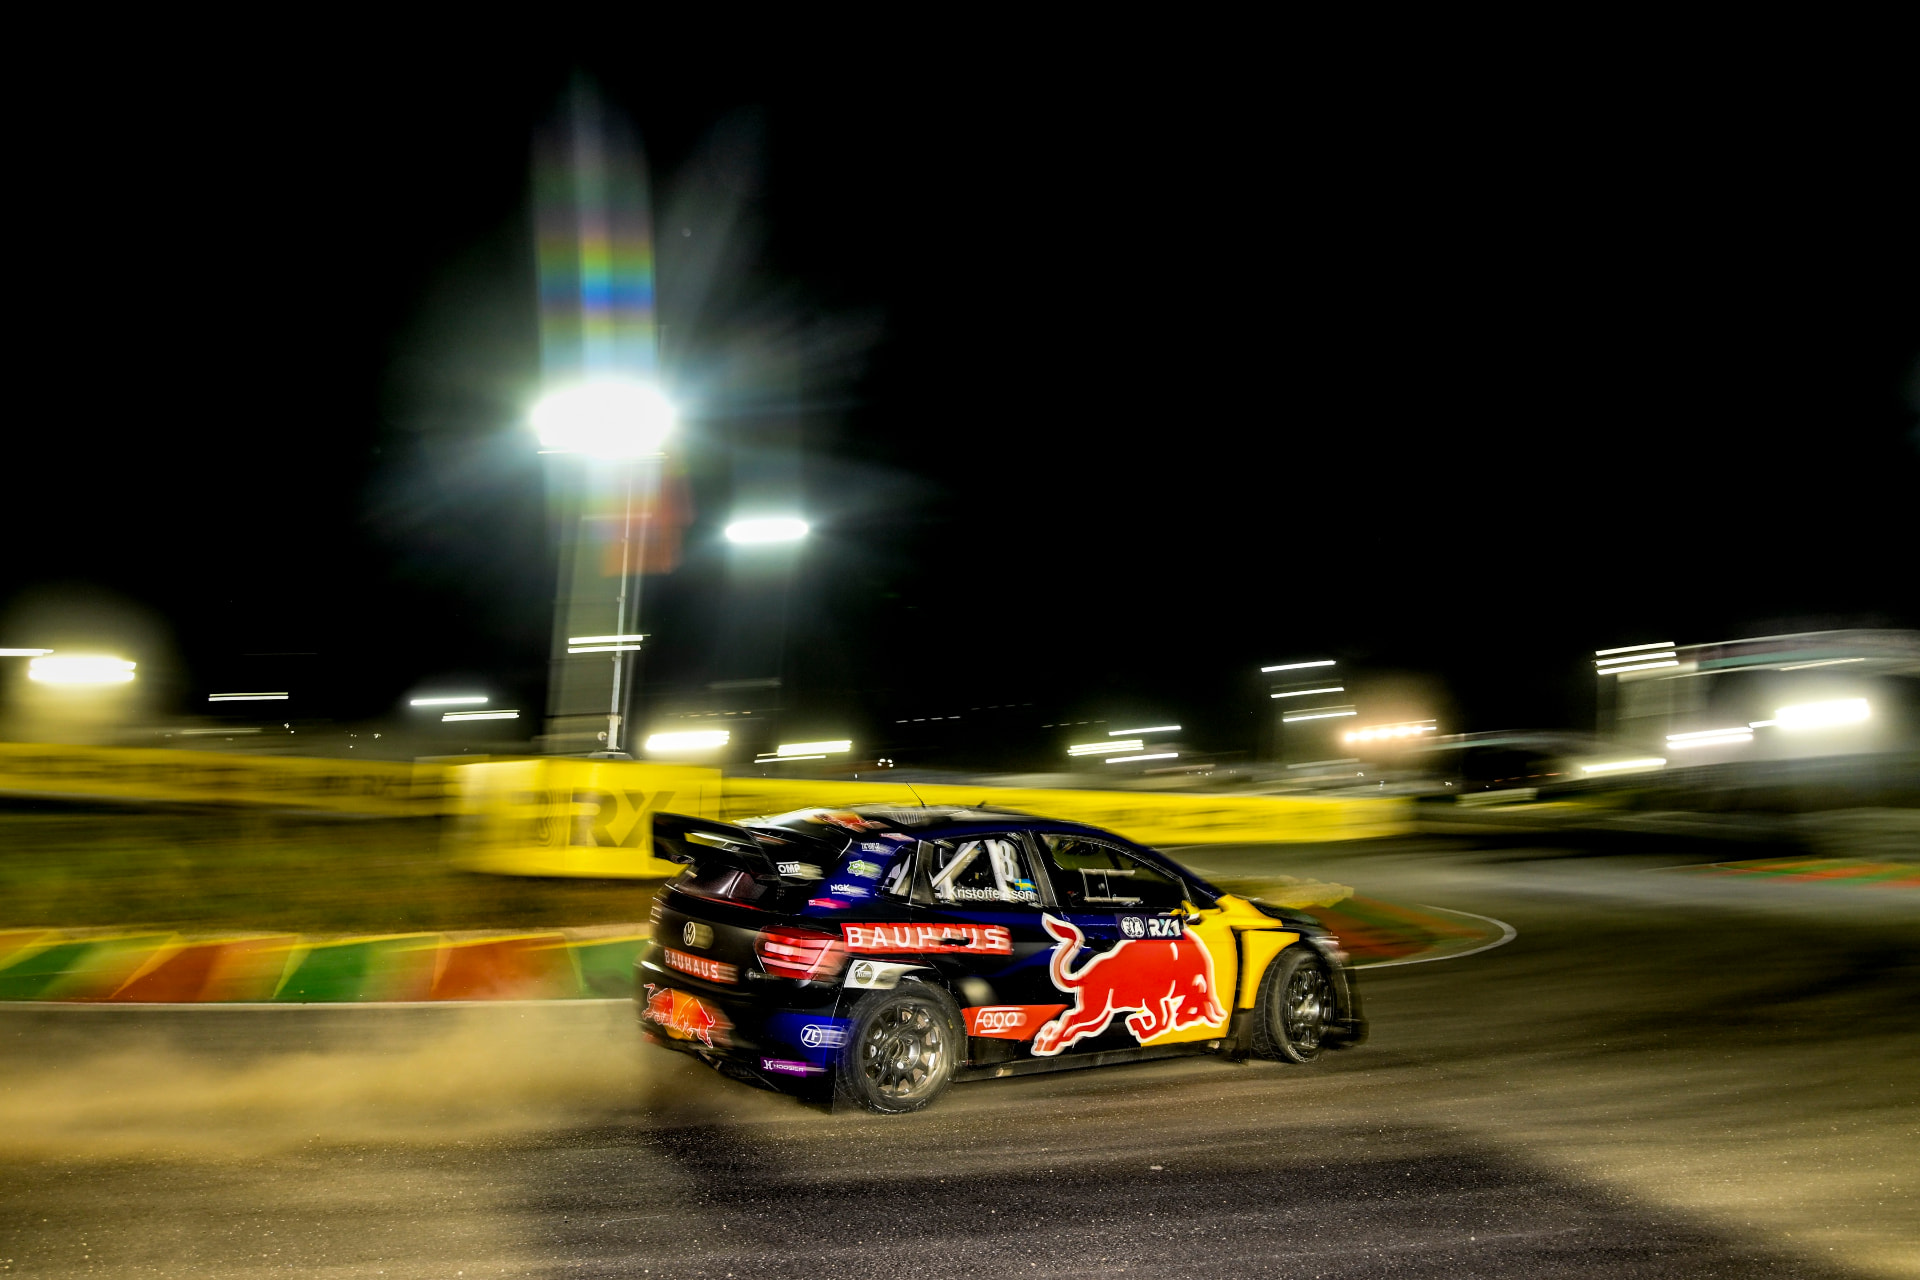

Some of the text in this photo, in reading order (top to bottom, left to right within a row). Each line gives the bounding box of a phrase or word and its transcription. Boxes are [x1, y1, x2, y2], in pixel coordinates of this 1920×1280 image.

[570, 787, 676, 848] RX
[777, 863, 801, 874] OMP
[845, 926, 1008, 949] BAUHAUS
[1121, 918, 1182, 938] FIA RX1
[664, 949, 719, 979] BAUHAUS
[802, 1026, 822, 1045] ZF
